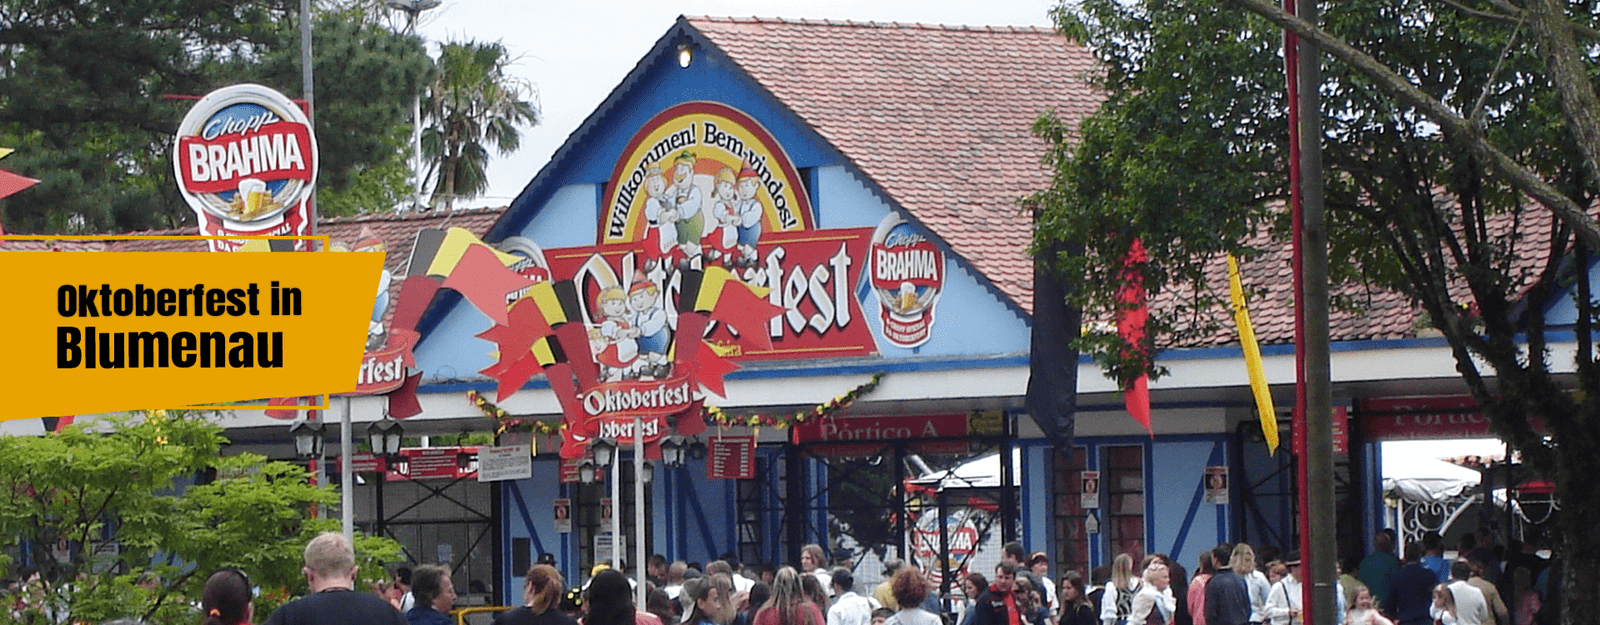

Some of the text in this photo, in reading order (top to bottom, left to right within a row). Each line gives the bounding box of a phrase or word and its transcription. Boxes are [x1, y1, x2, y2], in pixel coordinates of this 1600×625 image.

[202, 111, 279, 141] Chopp
[189, 133, 305, 181] BRAHMA
[609, 122, 797, 239] Willkommen! Bem-vindos!
[877, 249, 938, 281] BRAHMA
[584, 381, 689, 416] Oktoberfest
[921, 419, 939, 438] A
